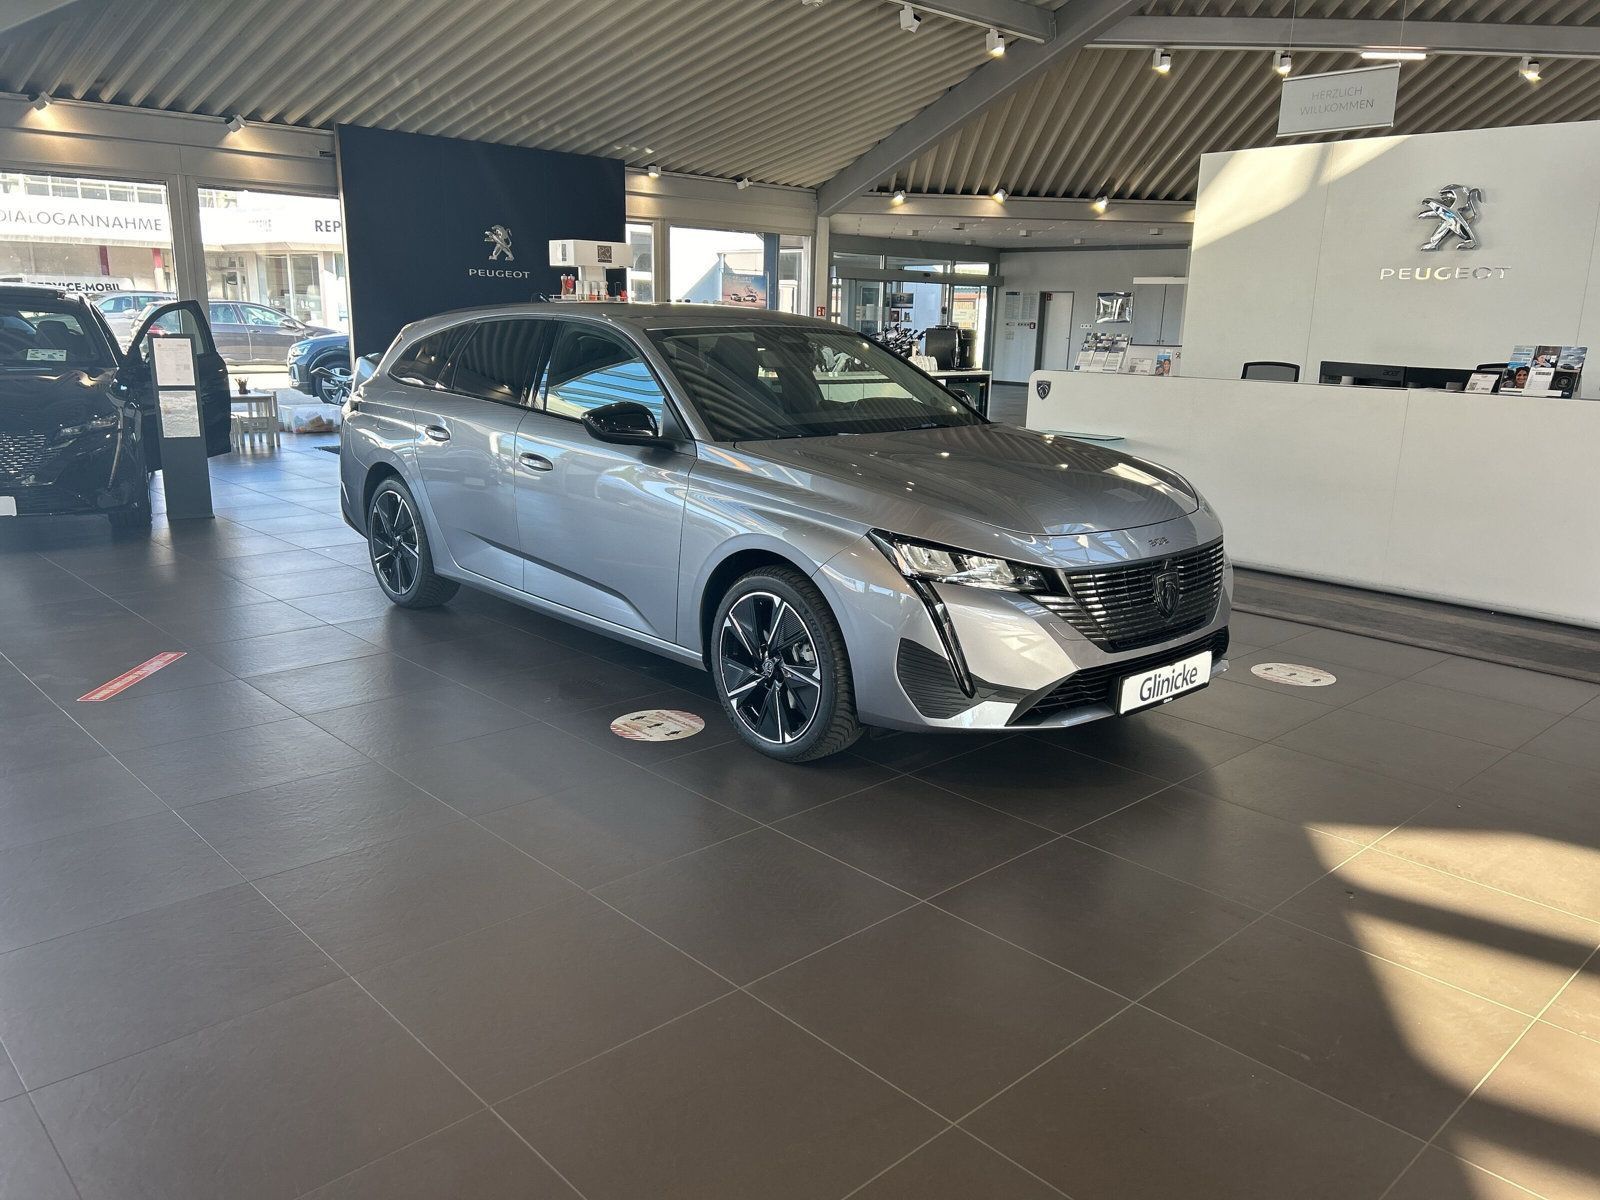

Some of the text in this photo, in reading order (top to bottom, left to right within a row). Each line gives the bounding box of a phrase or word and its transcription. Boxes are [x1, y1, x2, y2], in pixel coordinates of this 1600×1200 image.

[1311, 86, 1363, 100] HERZLICH
[1300, 98, 1375, 116] WILLKOMMEN
[468, 268, 531, 279] PEUGEOT
[1379, 266, 1512, 280] PEUGEOT
[1382, 369, 1401, 377] acer
[1139, 663, 1198, 702] Glinicke
